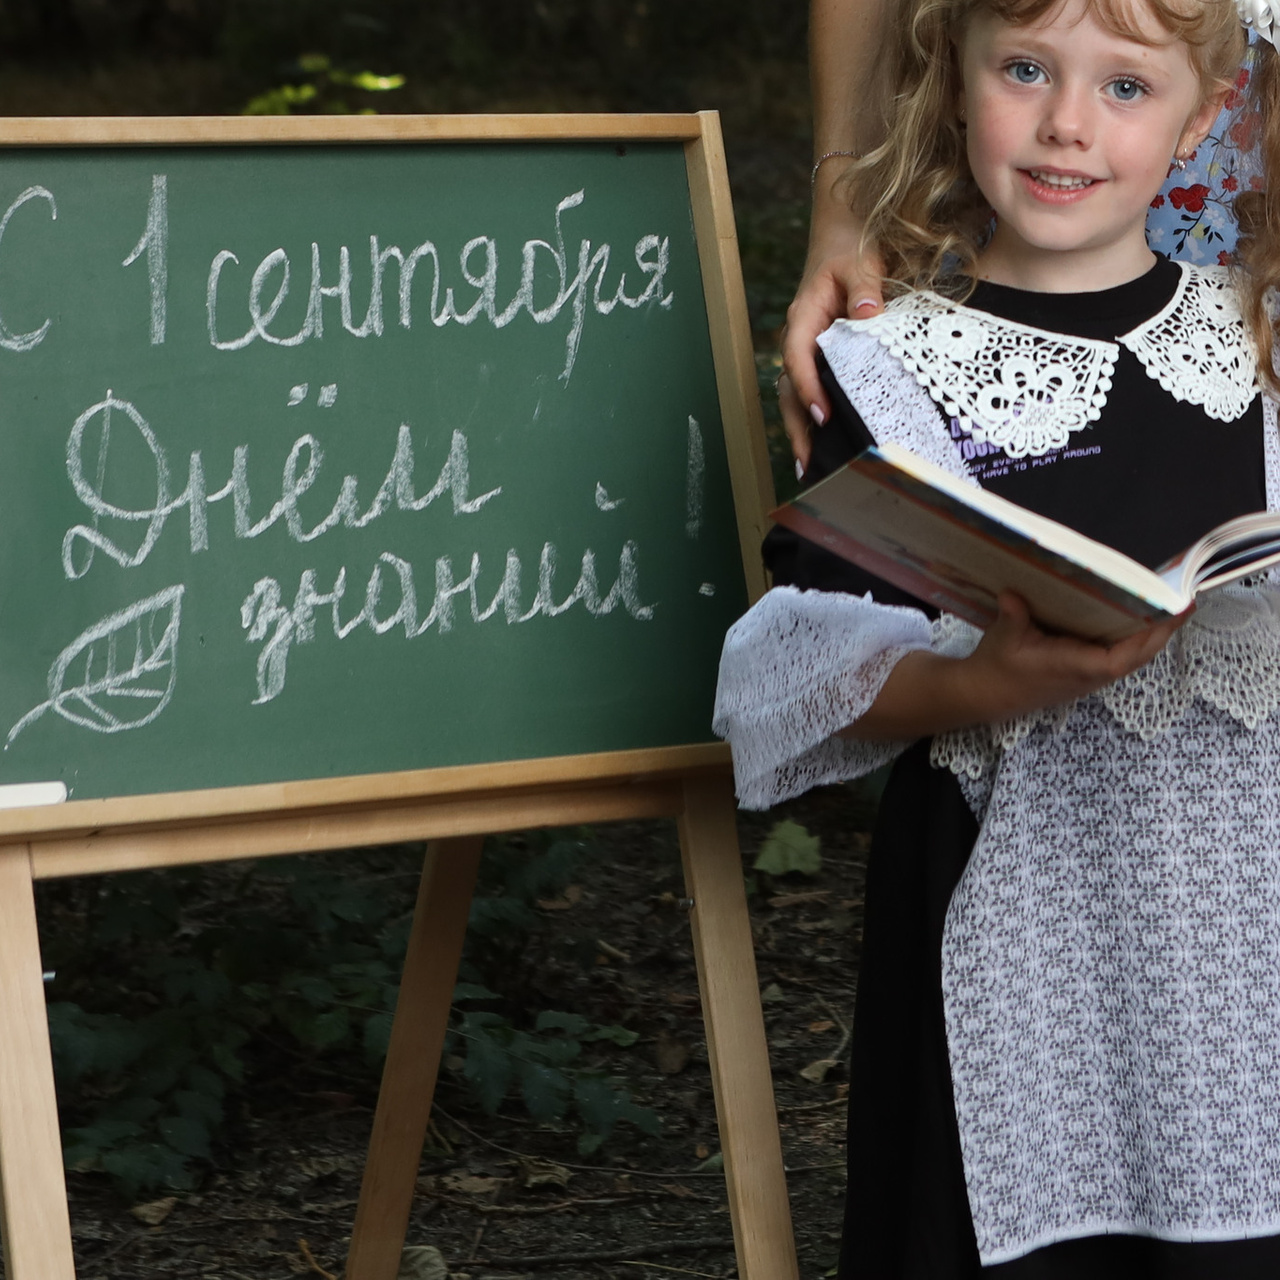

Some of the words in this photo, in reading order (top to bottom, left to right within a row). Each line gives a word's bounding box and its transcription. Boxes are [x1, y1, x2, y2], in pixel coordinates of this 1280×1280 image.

[123, 174, 169, 345] 1
[206, 189, 676, 389] сентября
[62, 383, 502, 579] Днём
[982, 466, 1009, 480] HAVE
[1014, 462, 1028, 472] TO
[1032, 455, 1057, 467] PLAY
[1063, 446, 1102, 459] AROUND
